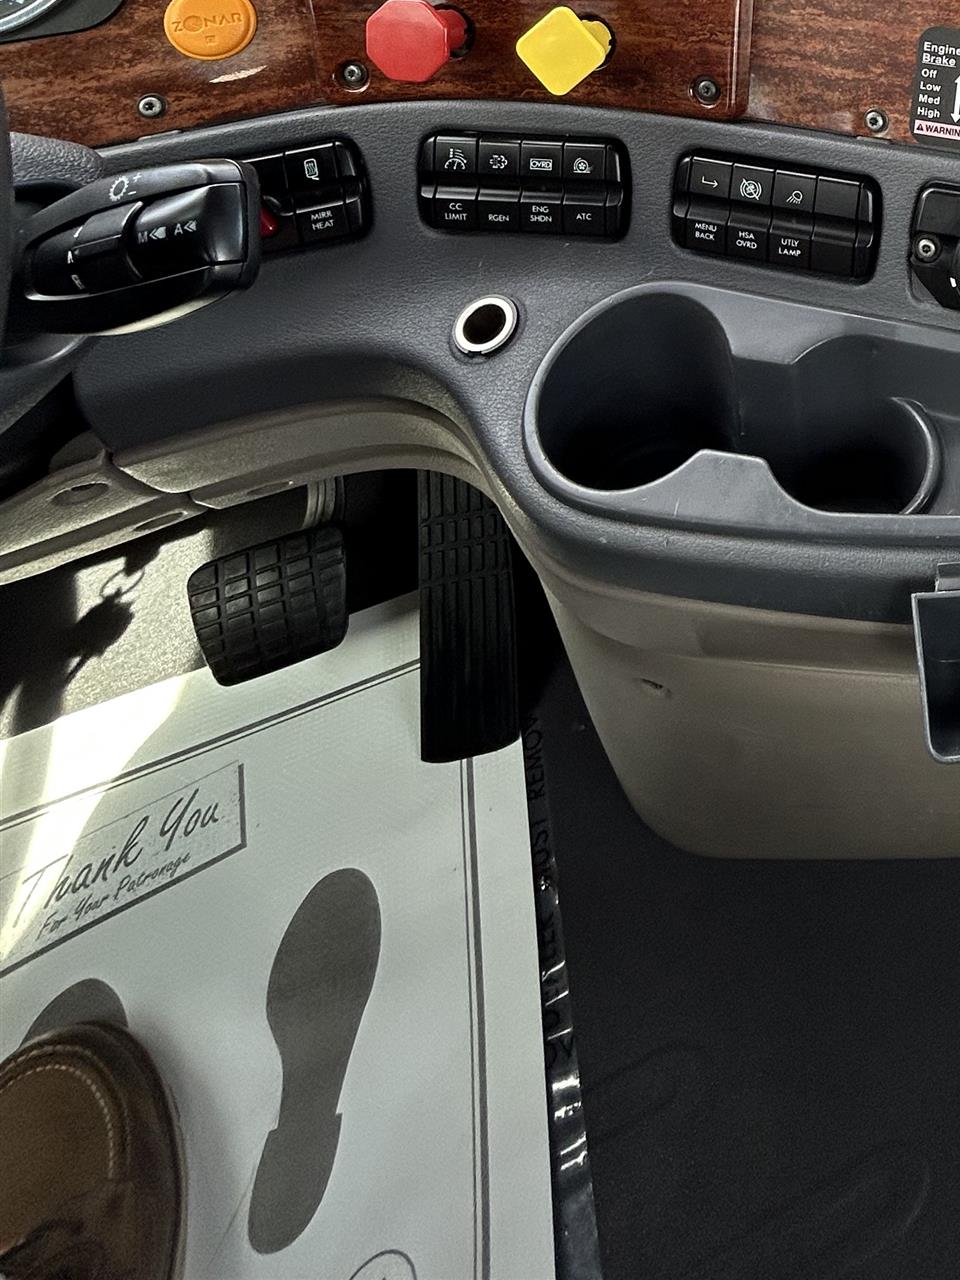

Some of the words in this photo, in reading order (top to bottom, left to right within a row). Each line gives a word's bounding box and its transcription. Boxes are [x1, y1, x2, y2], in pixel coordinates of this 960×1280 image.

[171, 12, 242, 33] ZONAR
[922, 52, 957, 67] Brake
[921, 68, 938, 79] Off
[919, 81, 941, 92] Low
[918, 94, 940, 105] Med
[917, 107, 940, 119] High
[531, 160, 552, 169] OVRD
[449, 203, 463, 211] CC
[532, 205, 549, 214] ENG
[310, 210, 333, 221] MIRR
[445, 213, 468, 221] LIMIT
[488, 214, 510, 222] RGEN
[530, 214, 552, 223] SHDN
[576, 213, 592, 221] ATC
[174, 223, 183, 236] A
[311, 219, 334, 231] HEAT
[695, 223, 717, 232] MENU
[138, 232, 148, 244] M
[695, 231, 715, 241] BACK
[738, 231, 755, 240] HSA
[736, 239, 758, 250] OVRD
[781, 238, 800, 247] UTLY
[778, 247, 802, 257] LAMP
[13, 815, 150, 928] Thank
[160, 788, 219, 851] You
[36, 911, 69, 942] For
[74, 893, 111, 921] Your
[114, 852, 192, 900] Patronage
